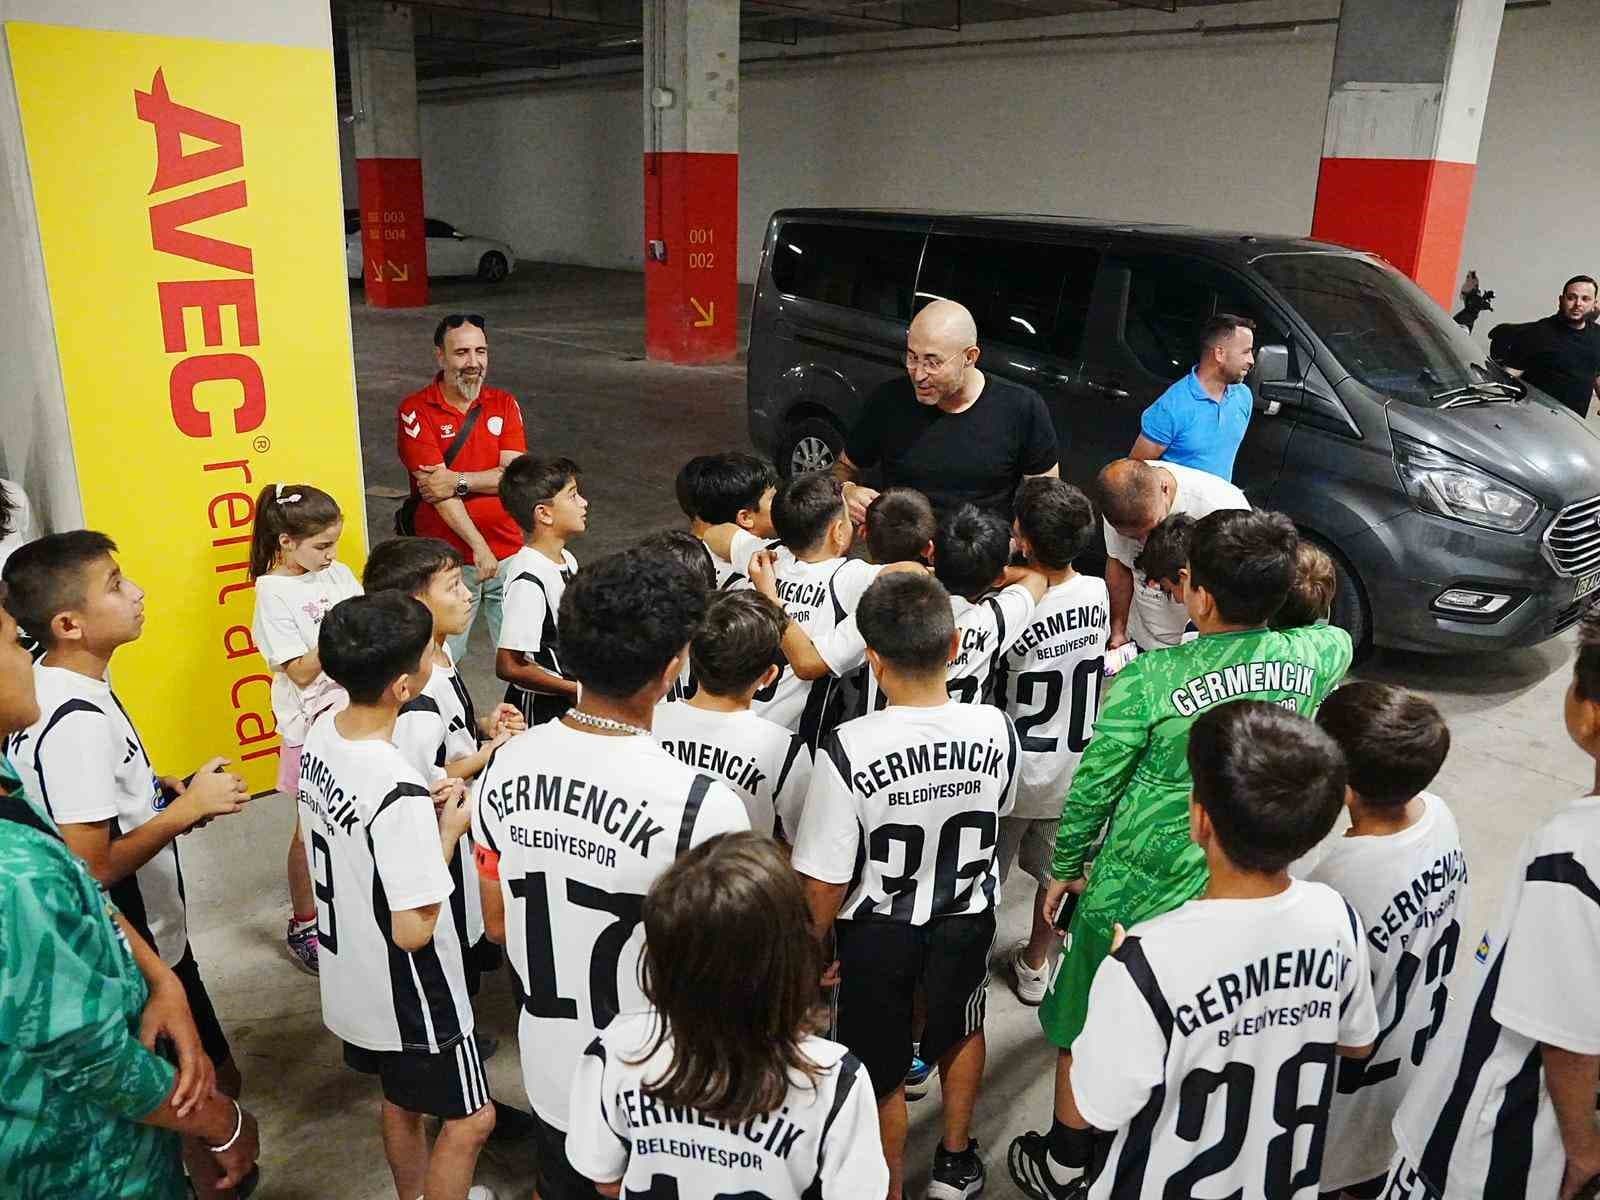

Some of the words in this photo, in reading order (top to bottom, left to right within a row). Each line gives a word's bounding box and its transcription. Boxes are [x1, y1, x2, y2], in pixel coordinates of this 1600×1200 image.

[688, 229, 714, 245] 001
[688, 252, 715, 269] 002
[1016, 655, 1105, 752] 20
[1169, 657, 1315, 717] GERMENCİK
[852, 737, 1004, 799] GERMENCİK
[887, 779, 982, 807] BELEDİYESPOR
[486, 773, 665, 859] GERMENCİK
[509, 826, 617, 868] BELEDİYESPOR
[853, 810, 997, 921] 36
[507, 870, 648, 1031] 17
[1162, 1042, 1338, 1200] 28
[637, 1137, 763, 1171] BELEDİYESPOR
